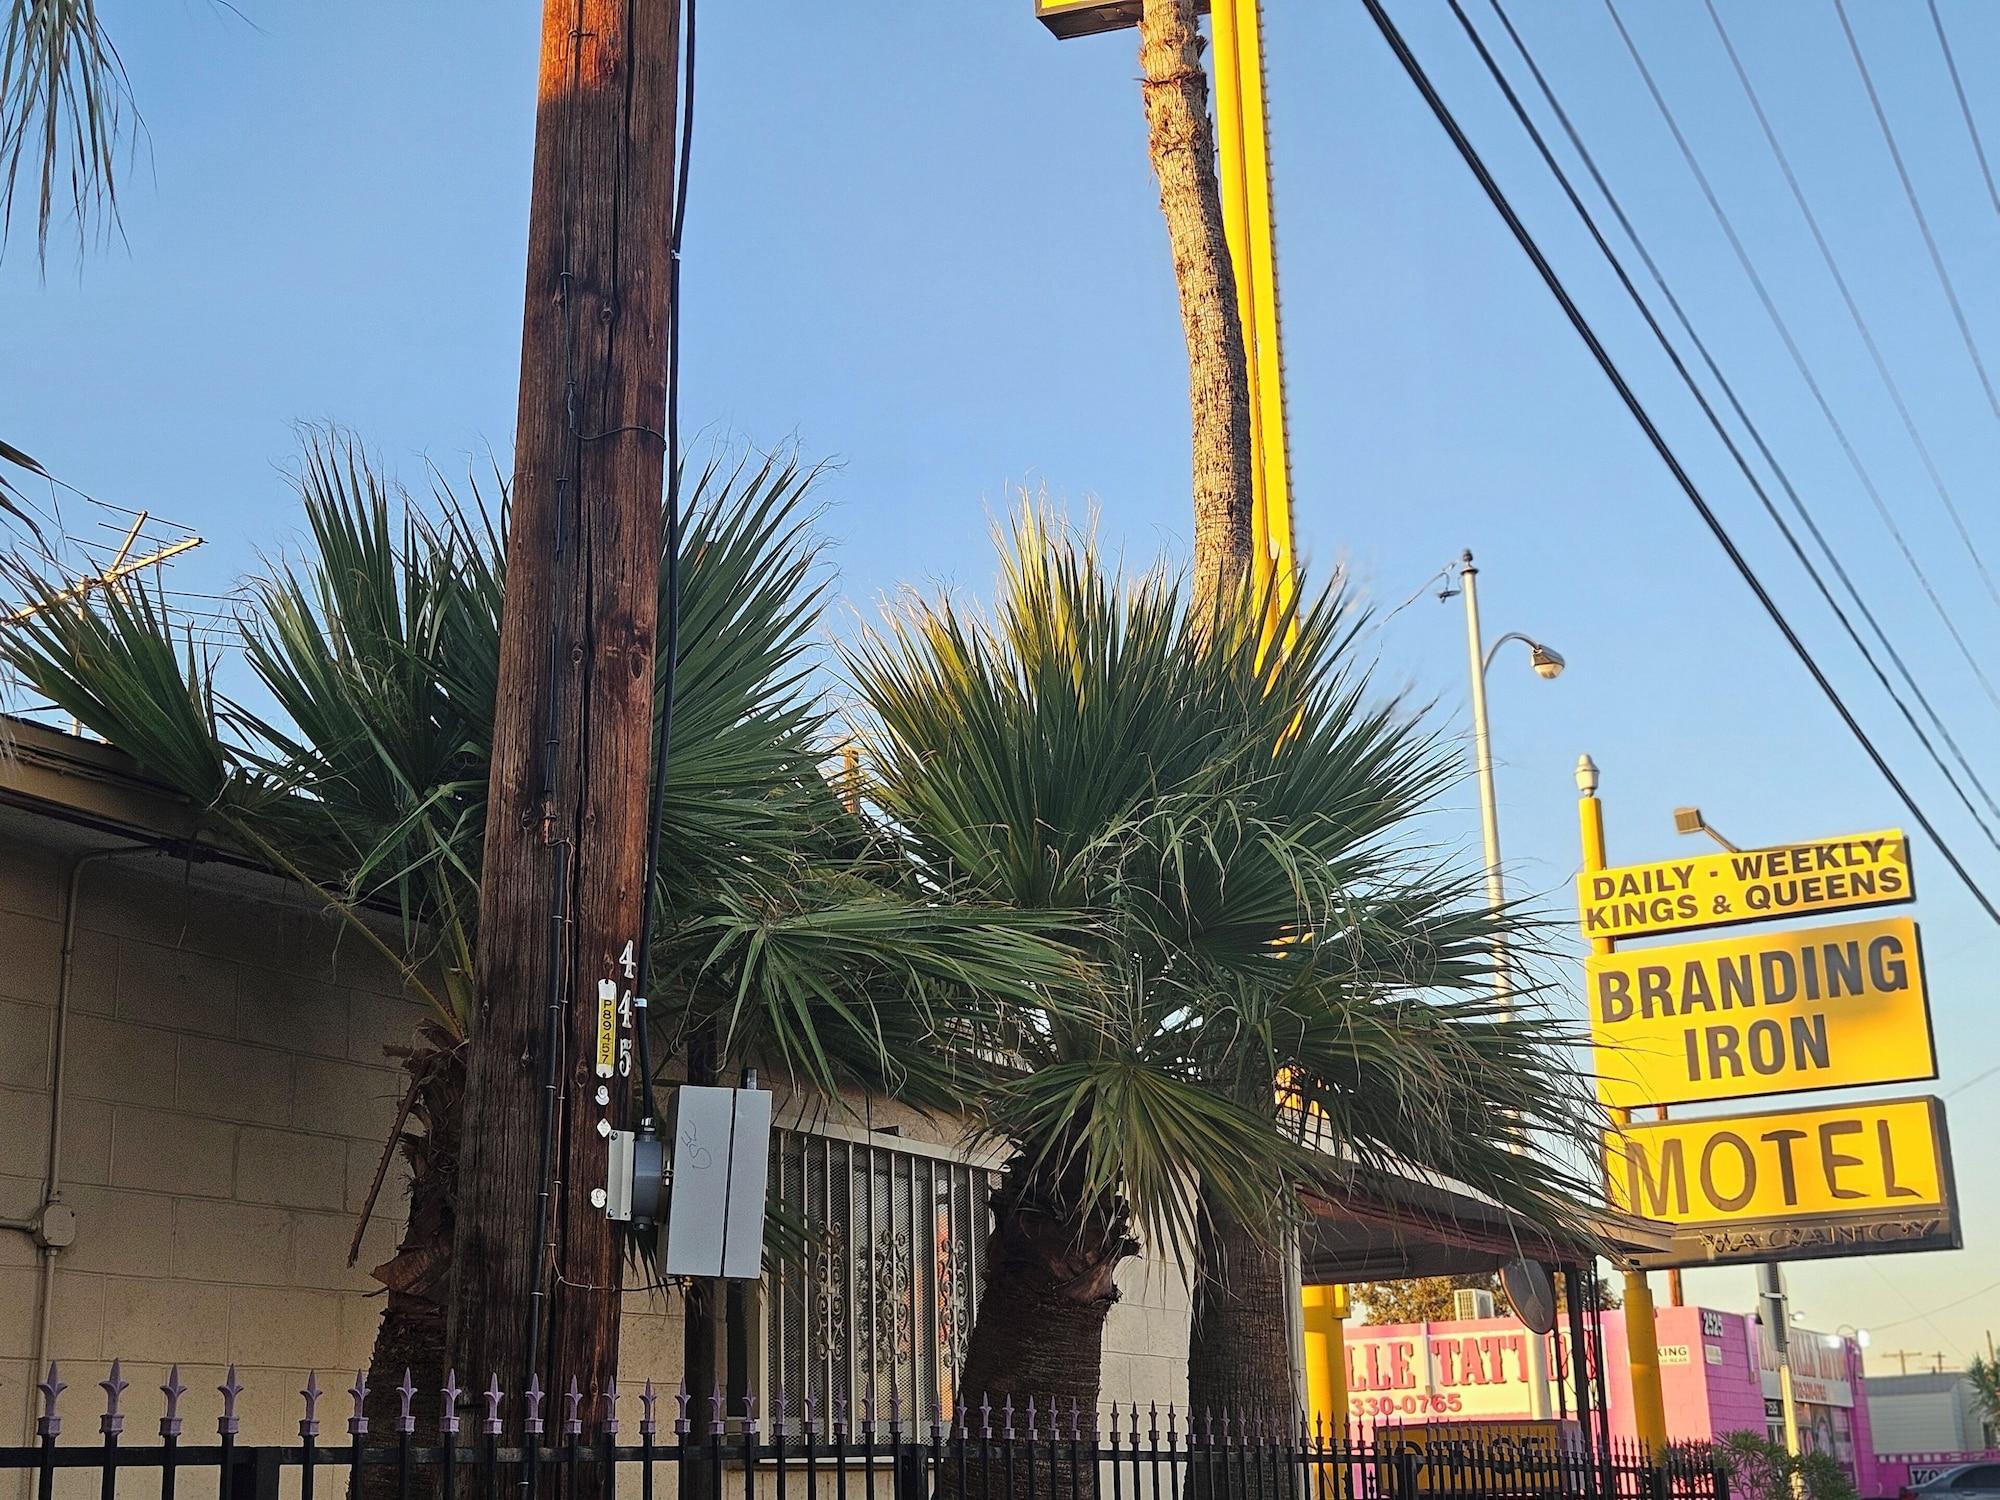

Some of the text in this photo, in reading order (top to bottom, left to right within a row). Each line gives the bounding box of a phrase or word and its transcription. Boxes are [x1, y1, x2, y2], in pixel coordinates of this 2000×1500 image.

[1586, 867, 1903, 932] KINGS & QUEENS
[1593, 864, 1695, 901] DAILY
[1731, 838, 1885, 882] WEEKLY
[1598, 935, 1909, 1024] BRANDING
[602, 999, 614, 1065] P89457
[1684, 1014, 1831, 1082] IRON
[1625, 1119, 1924, 1217] MOTEL
[1702, 1311, 1724, 1337] 2525
